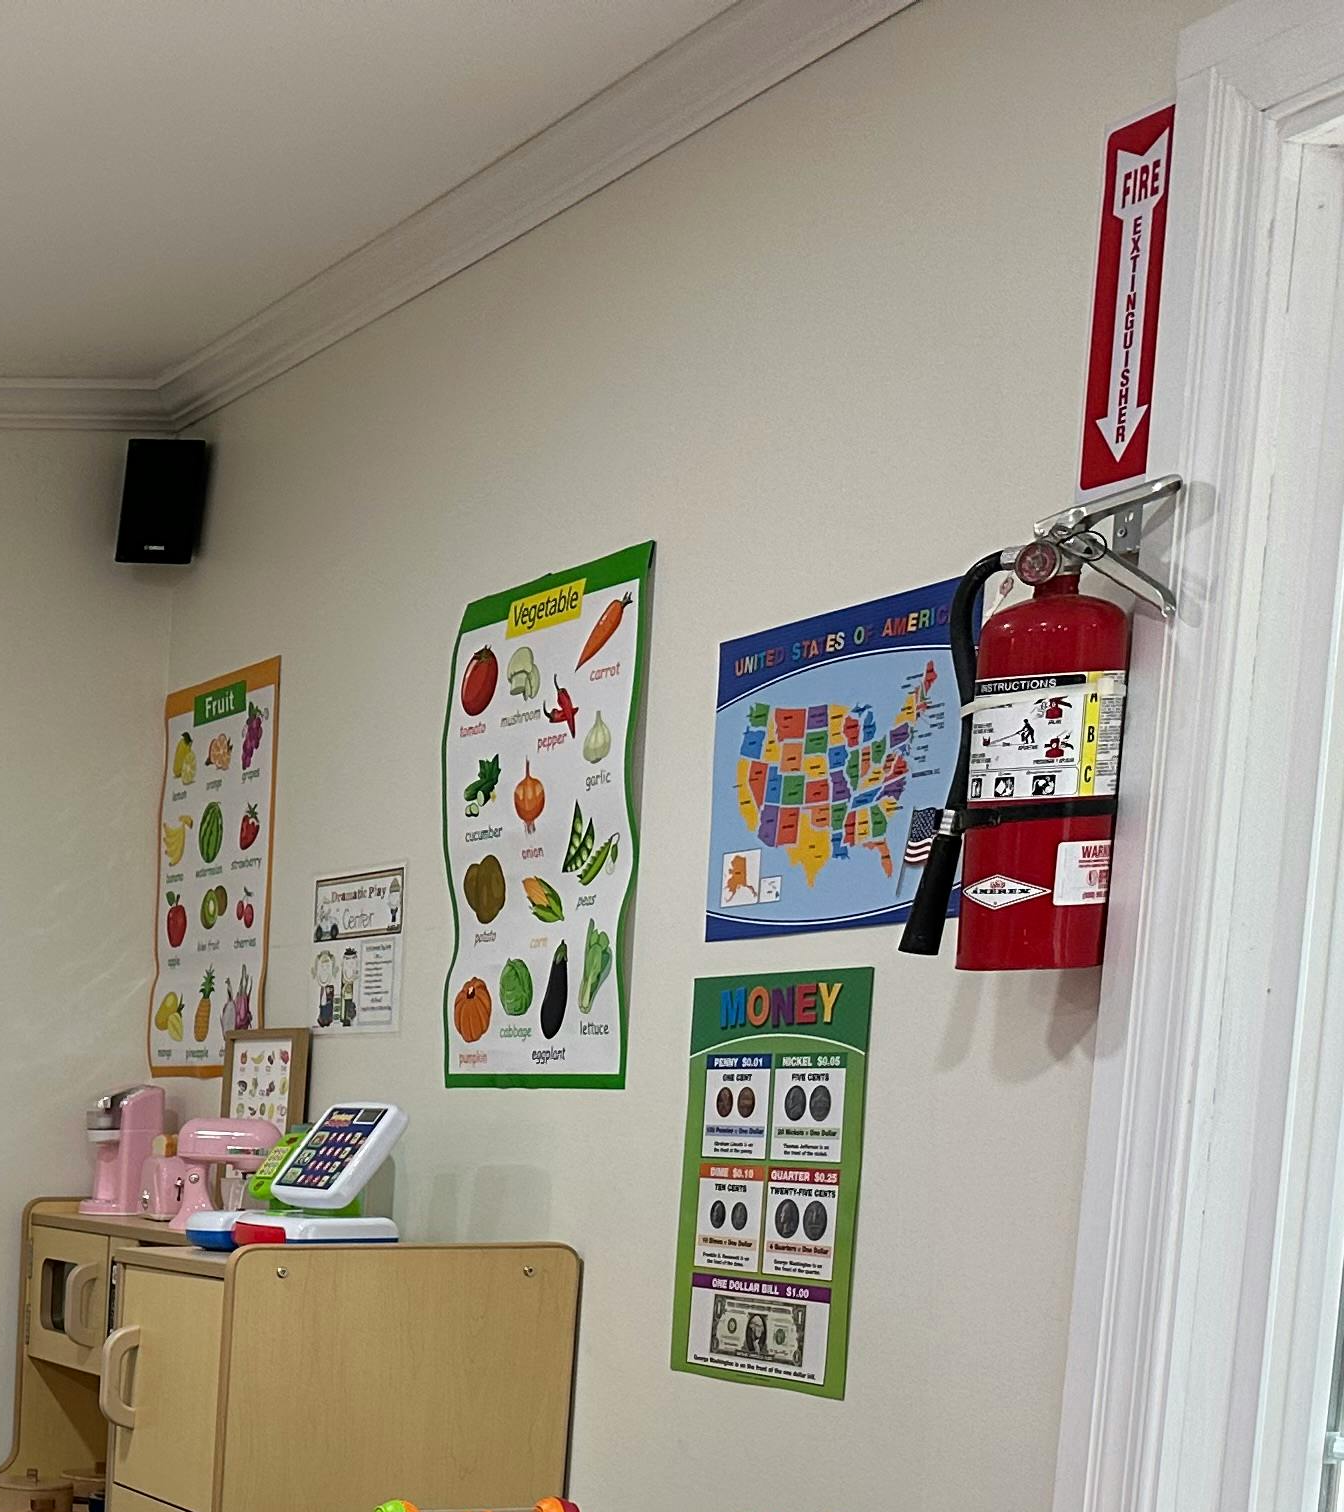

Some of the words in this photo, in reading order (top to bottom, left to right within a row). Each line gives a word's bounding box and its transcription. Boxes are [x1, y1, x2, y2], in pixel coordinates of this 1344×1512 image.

[1121, 159, 1161, 209] FIRE
[1115, 215, 1143, 444] EXTINGUISHER
[512, 586, 579, 630] Vegetable
[734, 646, 784, 676] UNITED
[792, 632, 845, 661] STATES
[853, 626, 873, 645] OF
[881, 606, 951, 637] AMERIC
[589, 662, 621, 682] carrot
[205, 690, 235, 719] Fruit
[500, 708, 541, 728] mushroom
[459, 721, 487, 738] tomato
[1088, 726, 1095, 743] B
[537, 731, 567, 753] pepper
[585, 769, 612, 791] garlic
[1084, 766, 1092, 782] C
[465, 826, 503, 843] cucumber
[521, 845, 545, 860] onion
[343, 908, 374, 929] Center
[720, 982, 843, 1029] MONEY
[579, 1020, 610, 1036] lettuce
[531, 1047, 566, 1065] eggplant
[714, 1057, 738, 1067] PENNY
[742, 1057, 763, 1067] $0.01
[782, 1057, 812, 1067] NICKEL
[771, 1170, 810, 1181] QUARTER
[770, 1187, 812, 1197] TWENTY-FIVE
[712, 1278, 727, 1289] ONE
[729, 1280, 760, 1293] DOLLAR
[761, 1285, 779, 1295] BILL
[786, 1287, 809, 1298] $1.00
